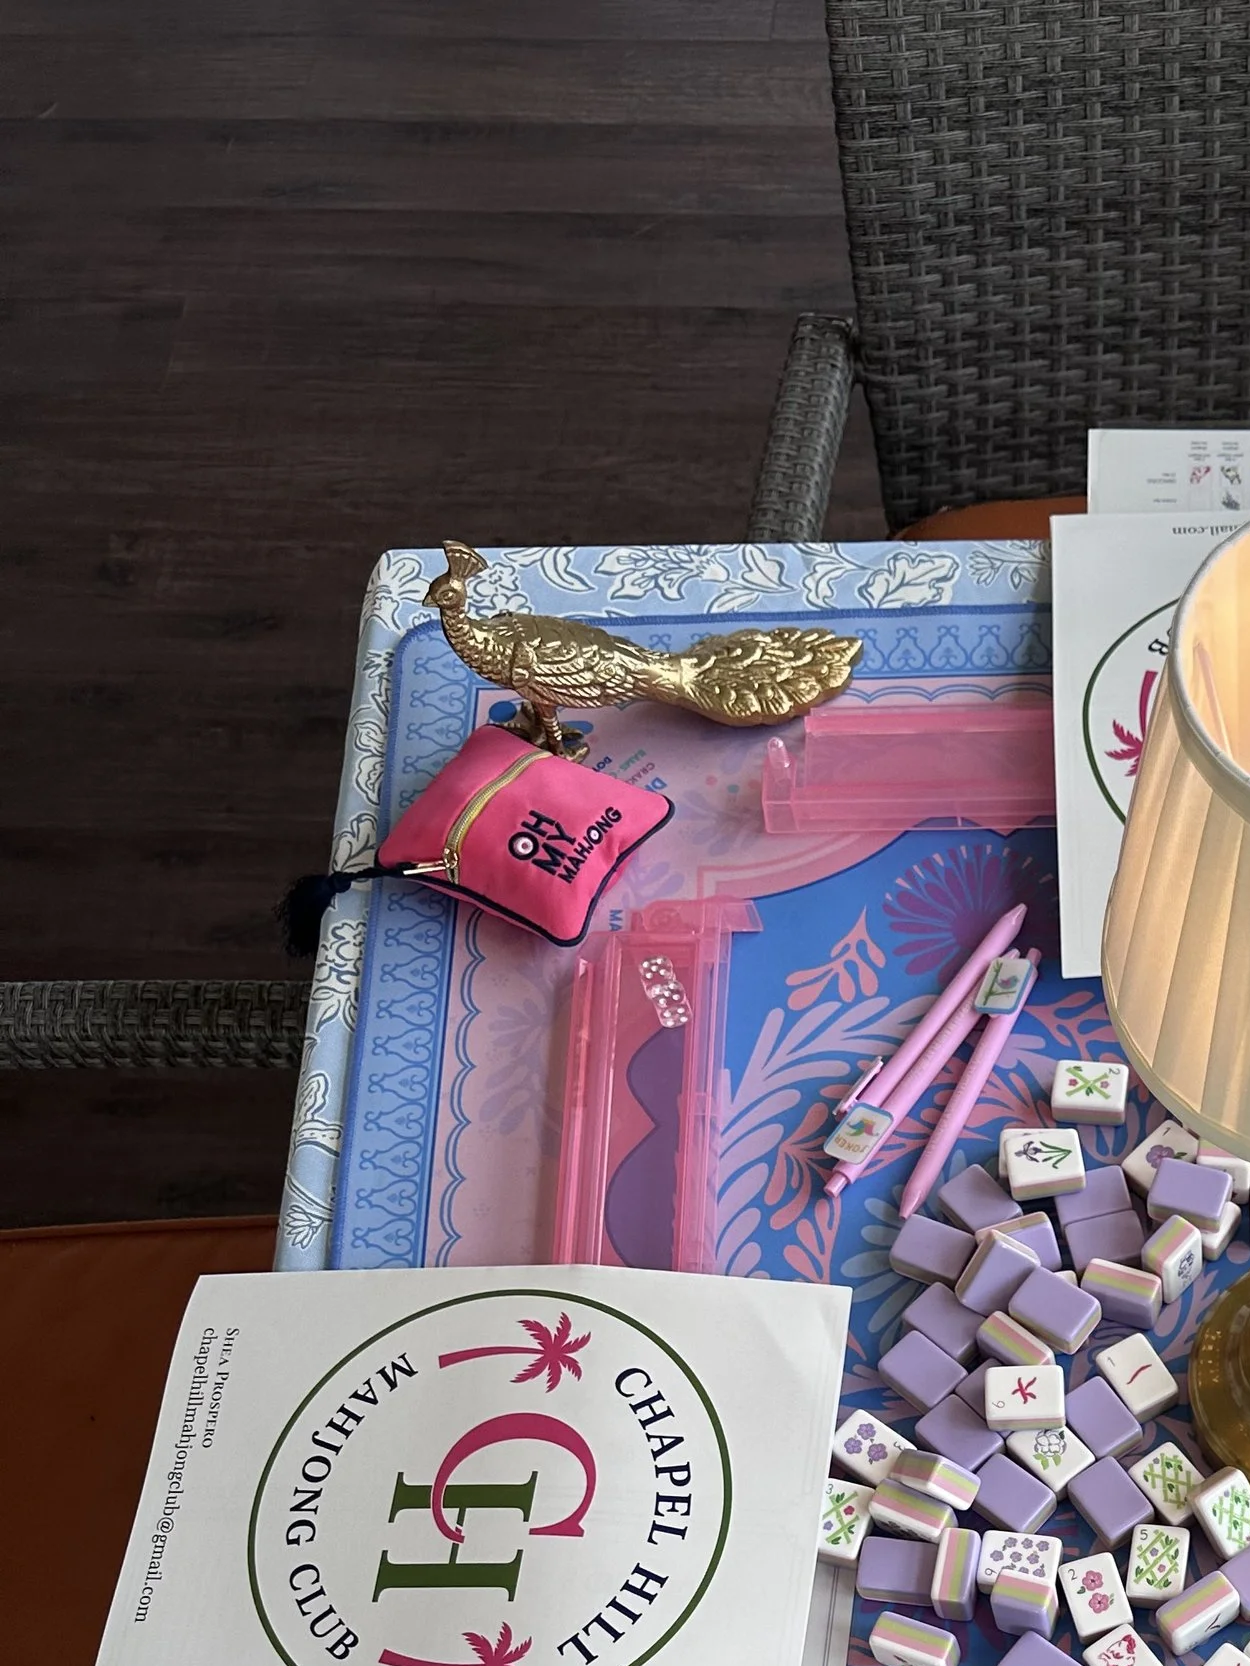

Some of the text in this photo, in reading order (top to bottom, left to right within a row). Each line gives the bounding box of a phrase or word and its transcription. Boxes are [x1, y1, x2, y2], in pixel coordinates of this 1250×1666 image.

[507, 809, 556, 861] OH
[531, 822, 577, 876] MY
[557, 806, 623, 884] MAHJONG
[834, 1134, 871, 1154] JOKER
[134, 1327, 216, 1623] chapelhillmahjongclub@gmail.com
[286, 1352, 418, 1660] MAHJONG CLUB
[557, 1368, 691, 1665] CHAPEL HILL
